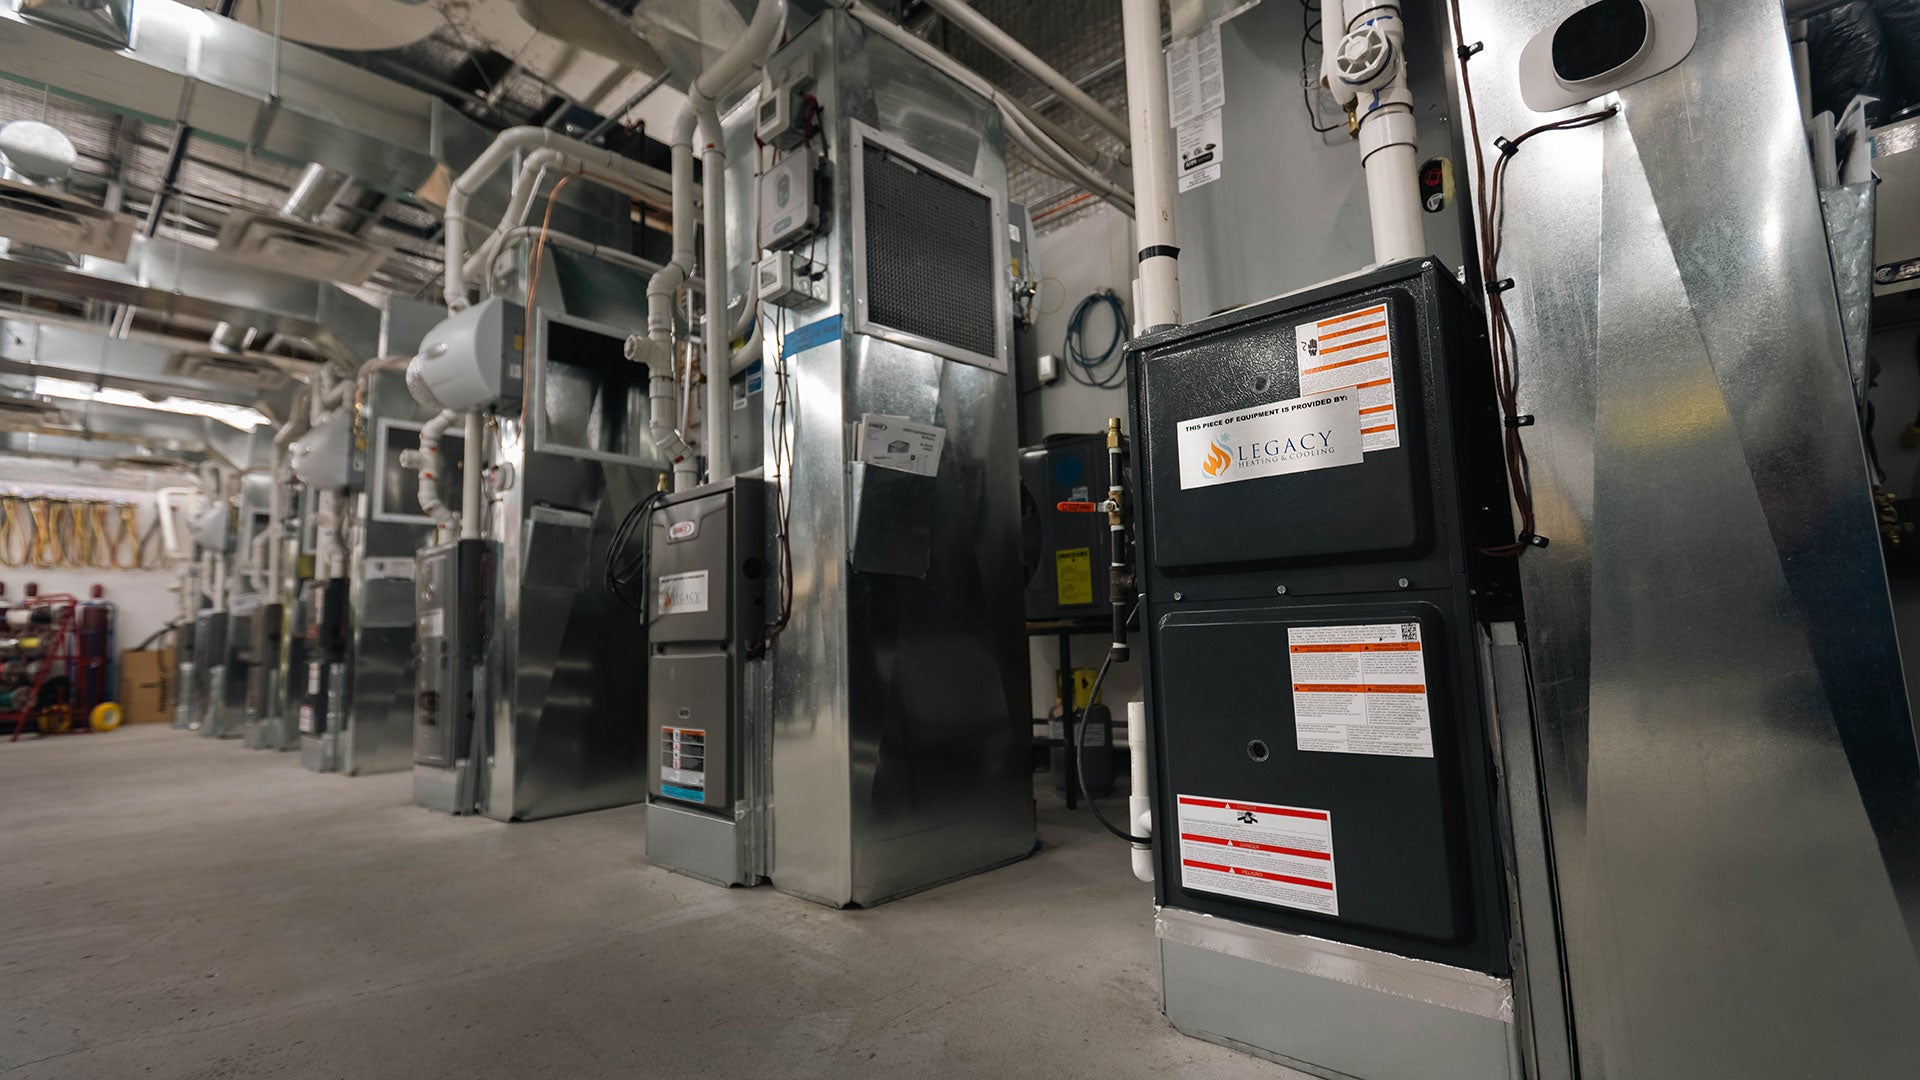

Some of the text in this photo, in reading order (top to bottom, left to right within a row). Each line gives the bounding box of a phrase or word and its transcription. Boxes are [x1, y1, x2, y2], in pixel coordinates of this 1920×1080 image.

[1185, 424, 1201, 432] THIS
[1202, 419, 1223, 429] PIECE
[1224, 417, 1235, 425] OF
[1236, 408, 1280, 422] EQUIPMENT
[1291, 397, 1332, 412] PROVIDED
[1333, 395, 1348, 404] BY:
[1238, 430, 1333, 461] LEGACY
[1238, 455, 1279, 469] HEATING
[1289, 446, 1335, 460] COOLING
